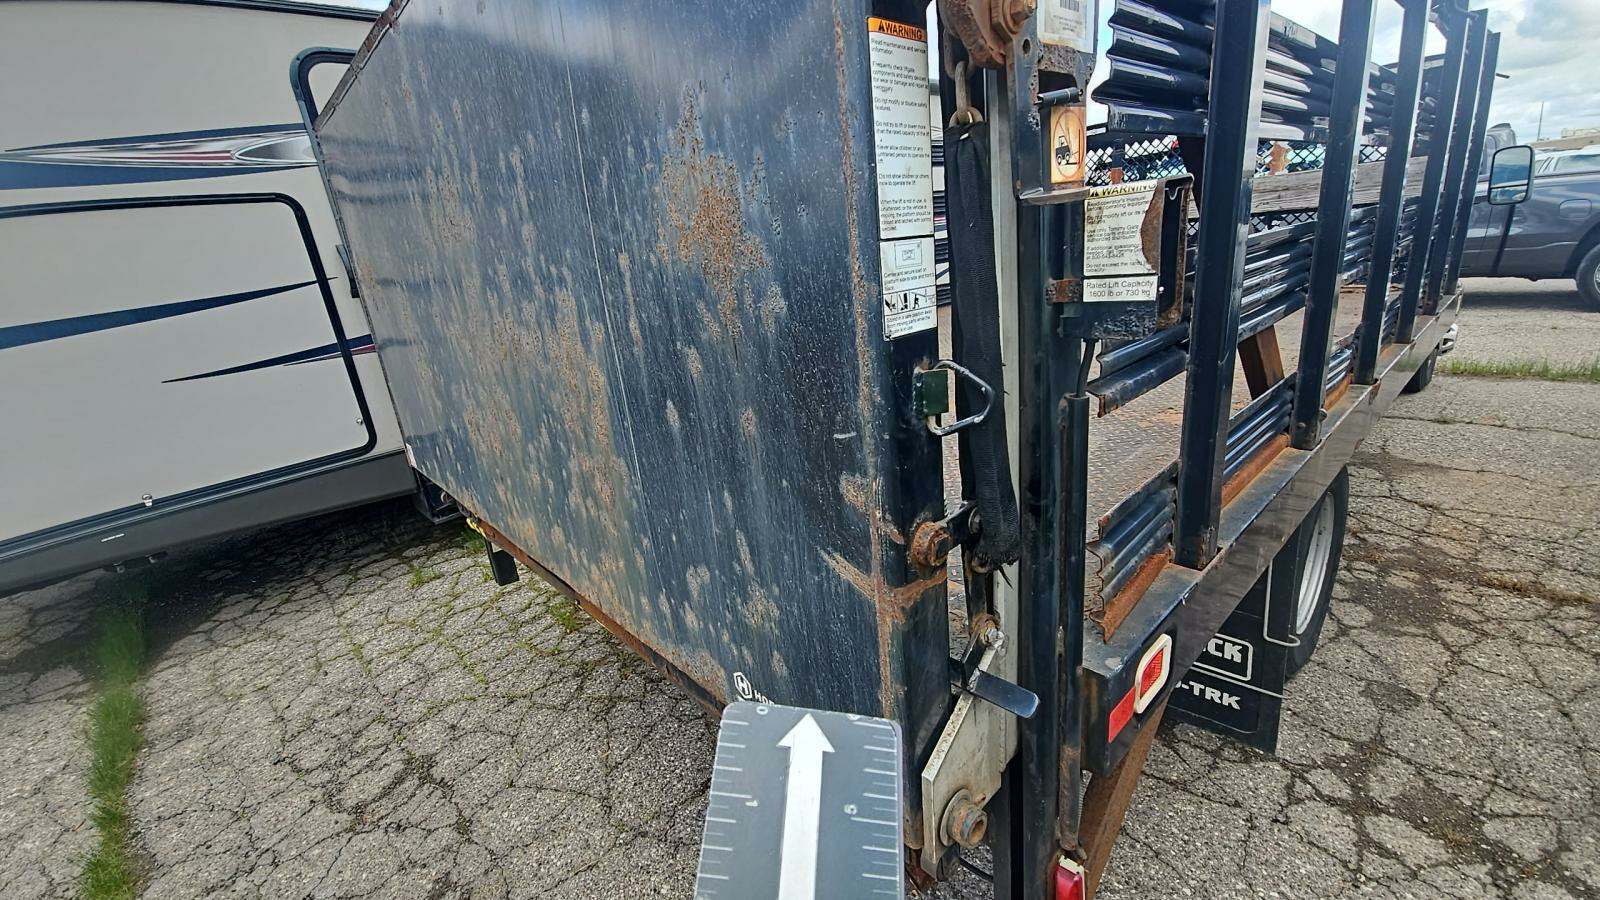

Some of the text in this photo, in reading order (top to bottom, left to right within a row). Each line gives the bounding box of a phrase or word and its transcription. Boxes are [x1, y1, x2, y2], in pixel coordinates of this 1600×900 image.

[885, 21, 923, 39] WARNING
[1121, 280, 1154, 288] Capacity
[1142, 289, 1151, 297] kg
[1203, 638, 1242, 663] CK
[1176, 680, 1240, 710] -TRK
